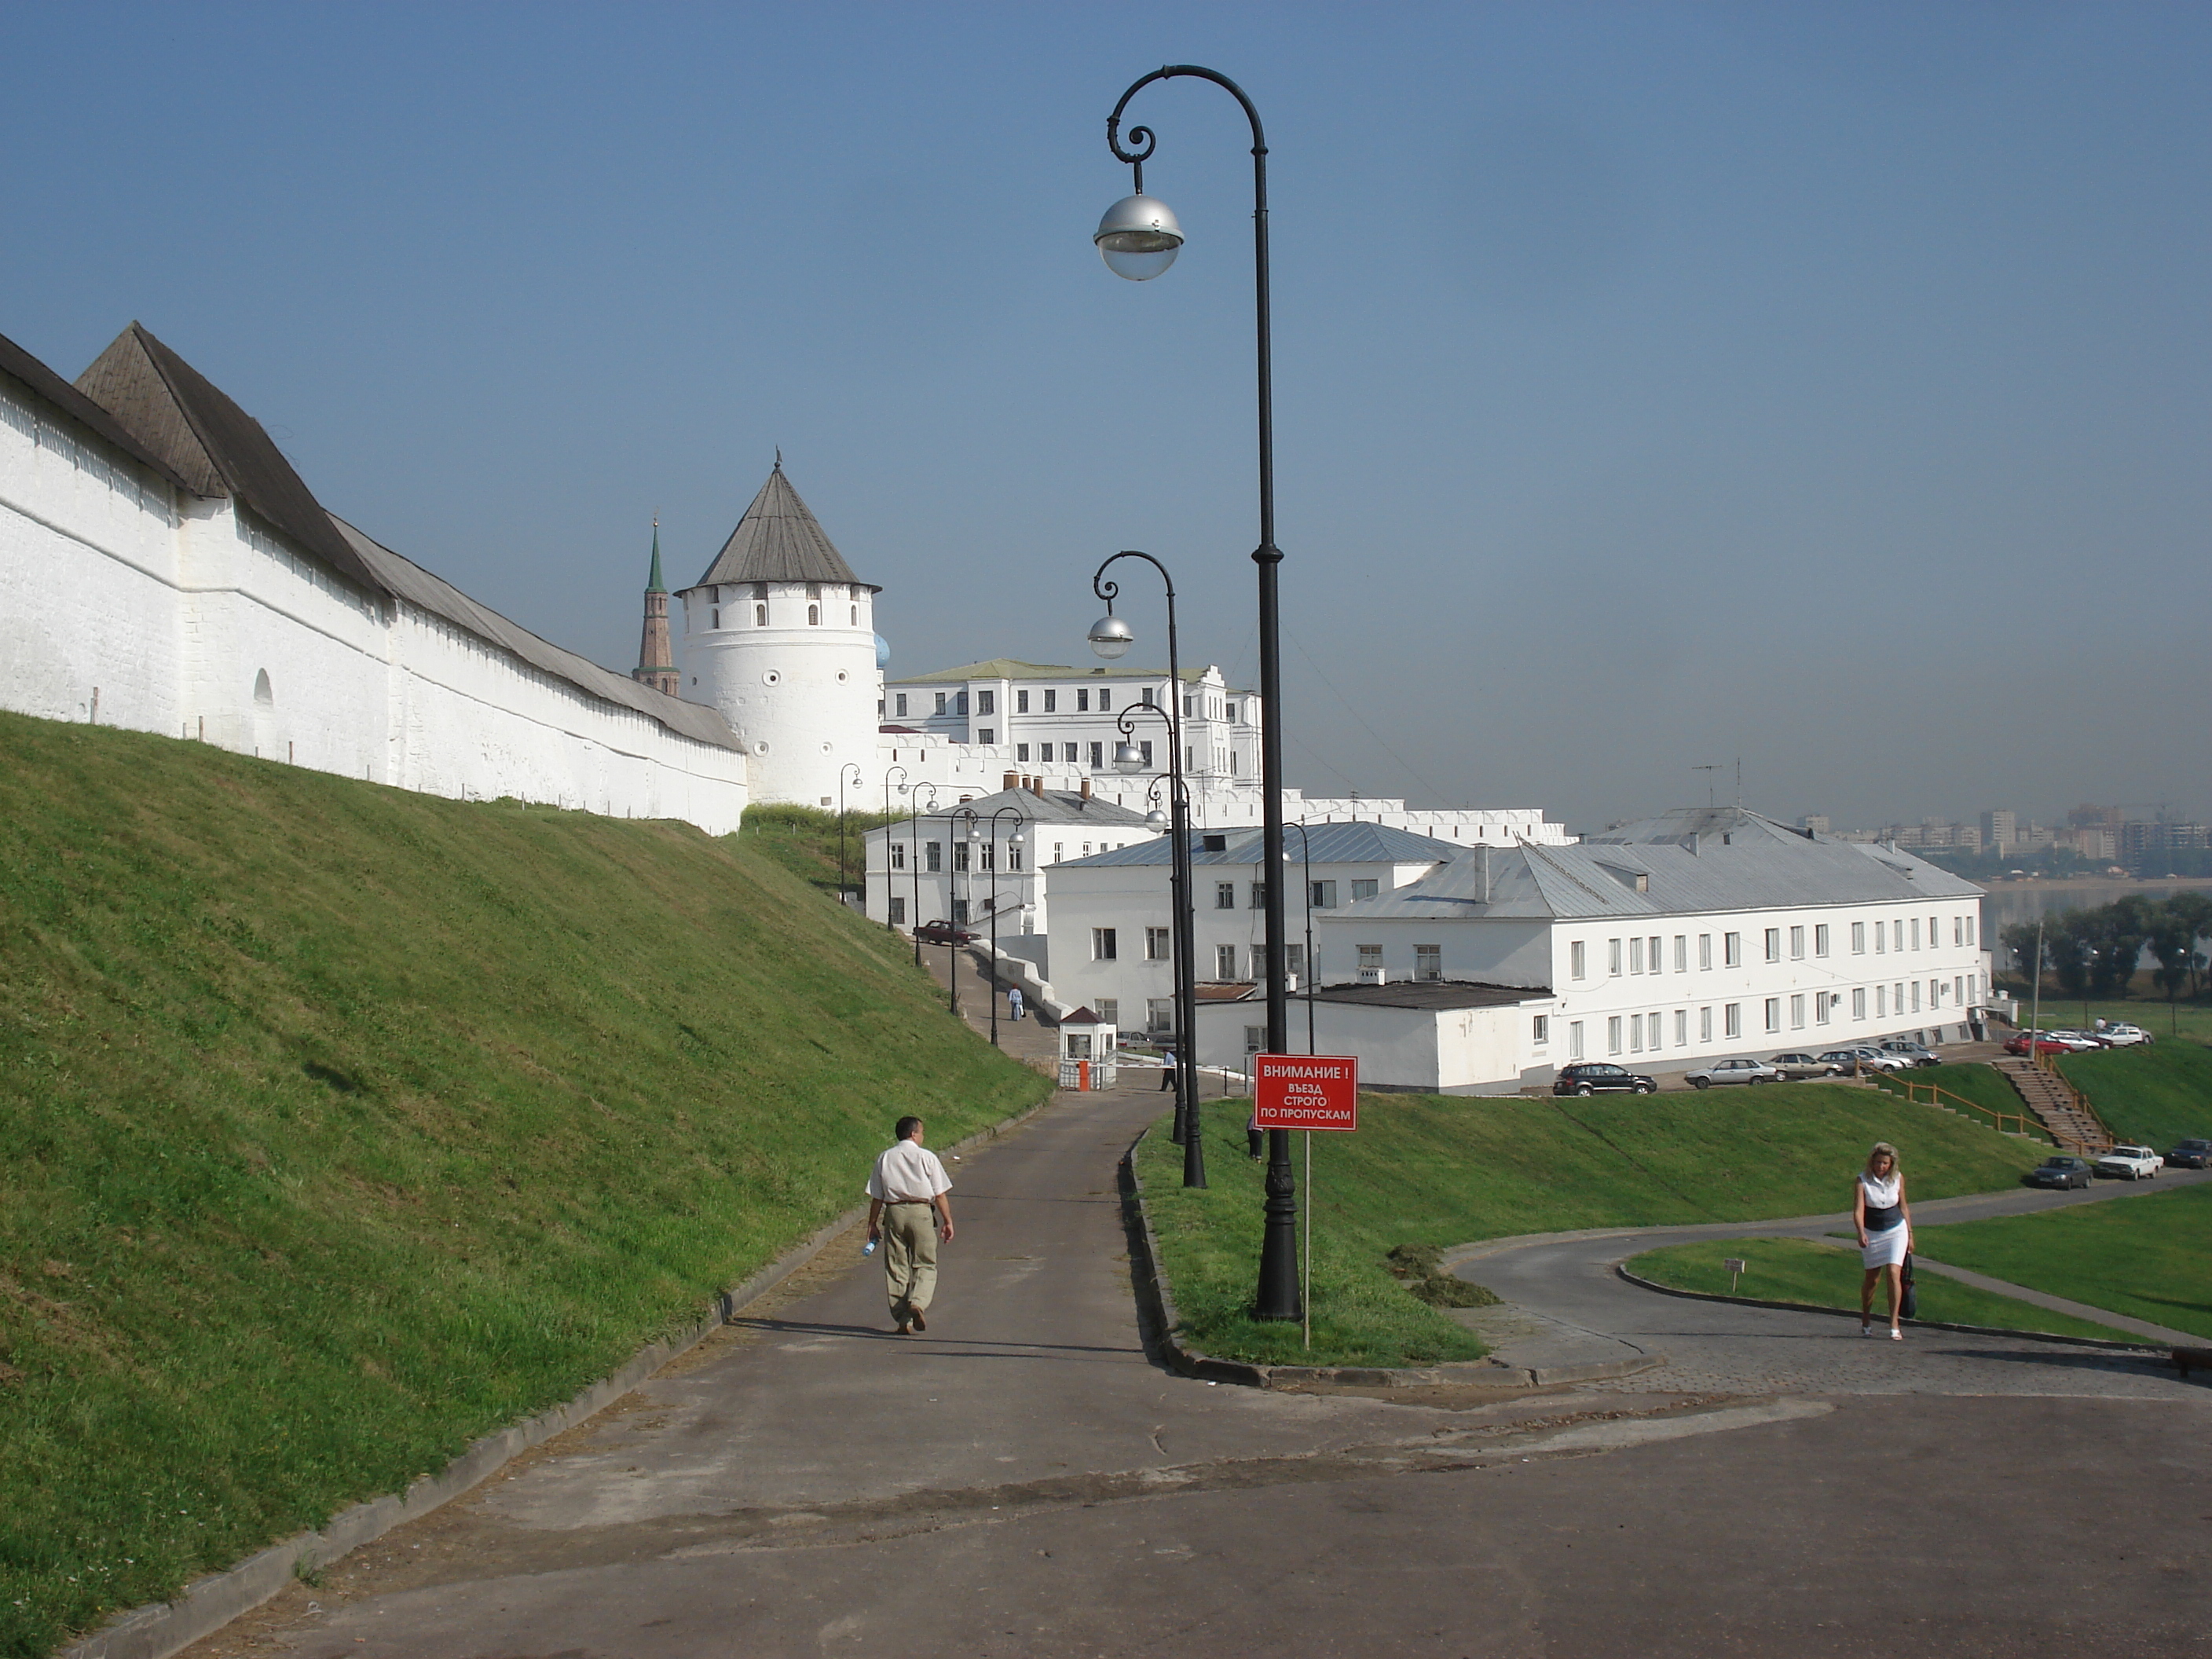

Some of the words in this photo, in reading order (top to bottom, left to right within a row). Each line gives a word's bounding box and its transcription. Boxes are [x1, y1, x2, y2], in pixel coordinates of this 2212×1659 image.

[1263, 1064, 1341, 1079] ВНИМАНИЕ
[1288, 1083, 1323, 1095] ВЪЕЗД
[1284, 1096, 1328, 1107] СТРОГО
[1261, 1108, 1277, 1118] ПО
[1280, 1108, 1350, 1120] ПРОПУСКАМ
